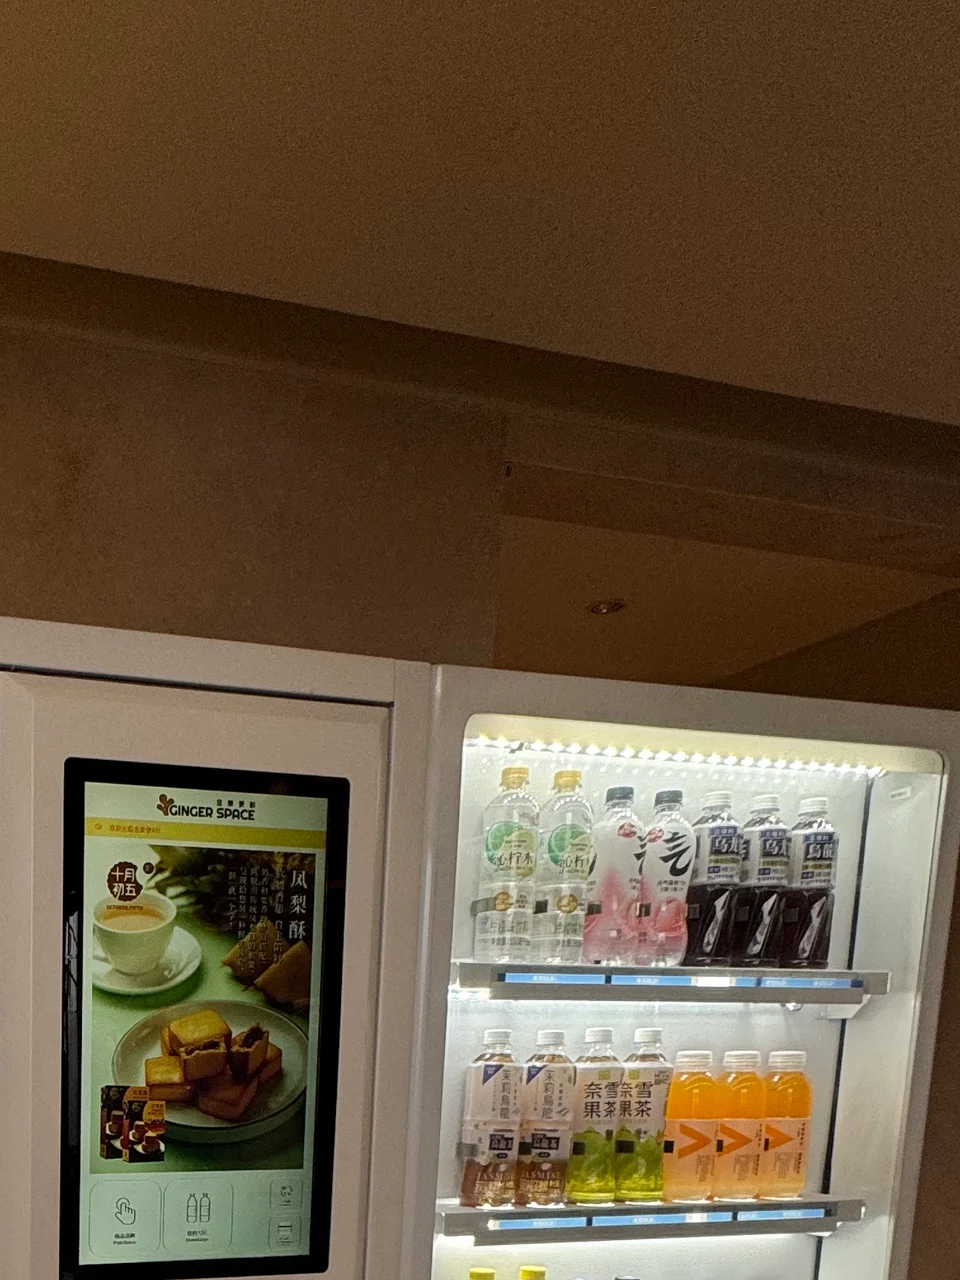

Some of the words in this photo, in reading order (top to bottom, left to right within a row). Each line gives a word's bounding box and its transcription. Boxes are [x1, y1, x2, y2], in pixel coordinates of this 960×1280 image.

[169, 804, 213, 818] GINGER
[216, 808, 255, 820] SPACE
[111, 868, 135, 882] 十月
[112, 882, 137, 896] 初五
[289, 870, 308, 940] 凤梨酥
[584, 1083, 618, 1099] 奈雪
[620, 1083, 653, 1099] 奈雪
[584, 1101, 618, 1118] 果茶
[620, 1101, 652, 1118] 果茶
